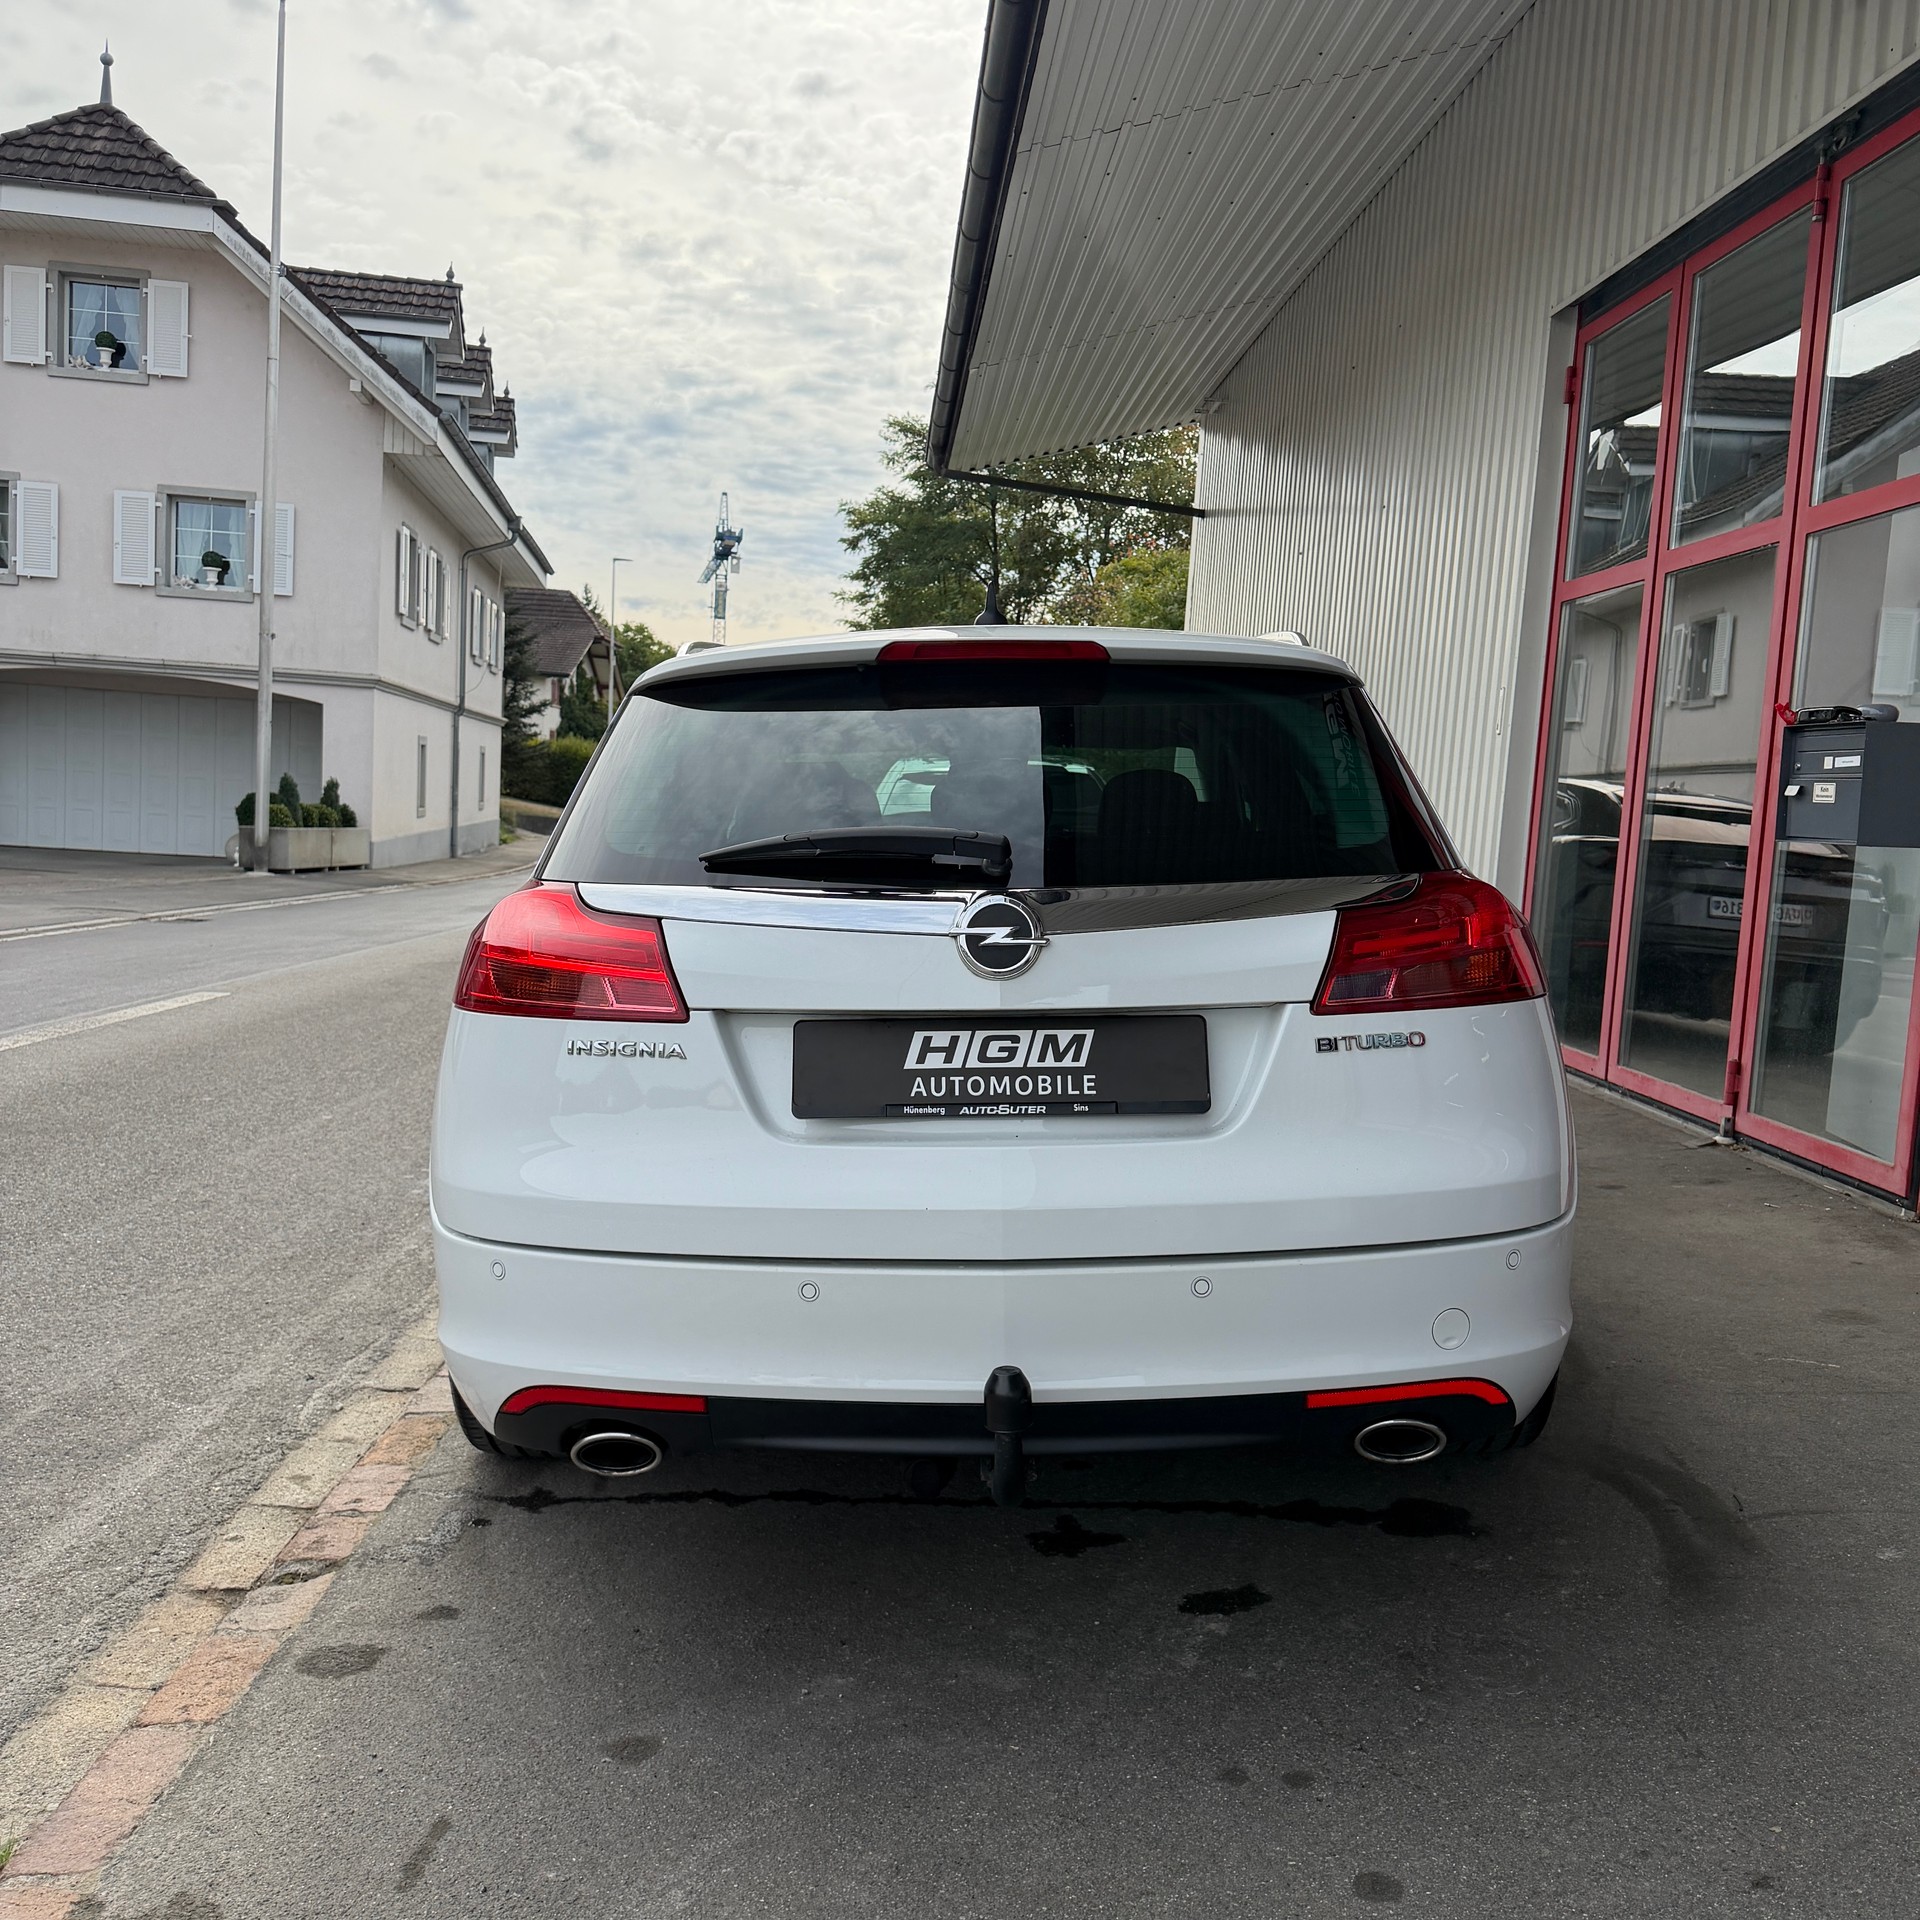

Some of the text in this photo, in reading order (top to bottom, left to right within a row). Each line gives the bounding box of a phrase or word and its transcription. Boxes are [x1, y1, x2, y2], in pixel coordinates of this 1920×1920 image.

[567, 1039, 687, 1060] INSIGNIA
[908, 1031, 1092, 1067] HGM
[1315, 1031, 1426, 1053] BITURBO
[910, 1074, 1097, 1097] AUTOMOBILE
[903, 1104, 946, 1115] Hünenberg
[1073, 1103, 1089, 1112] Sins
